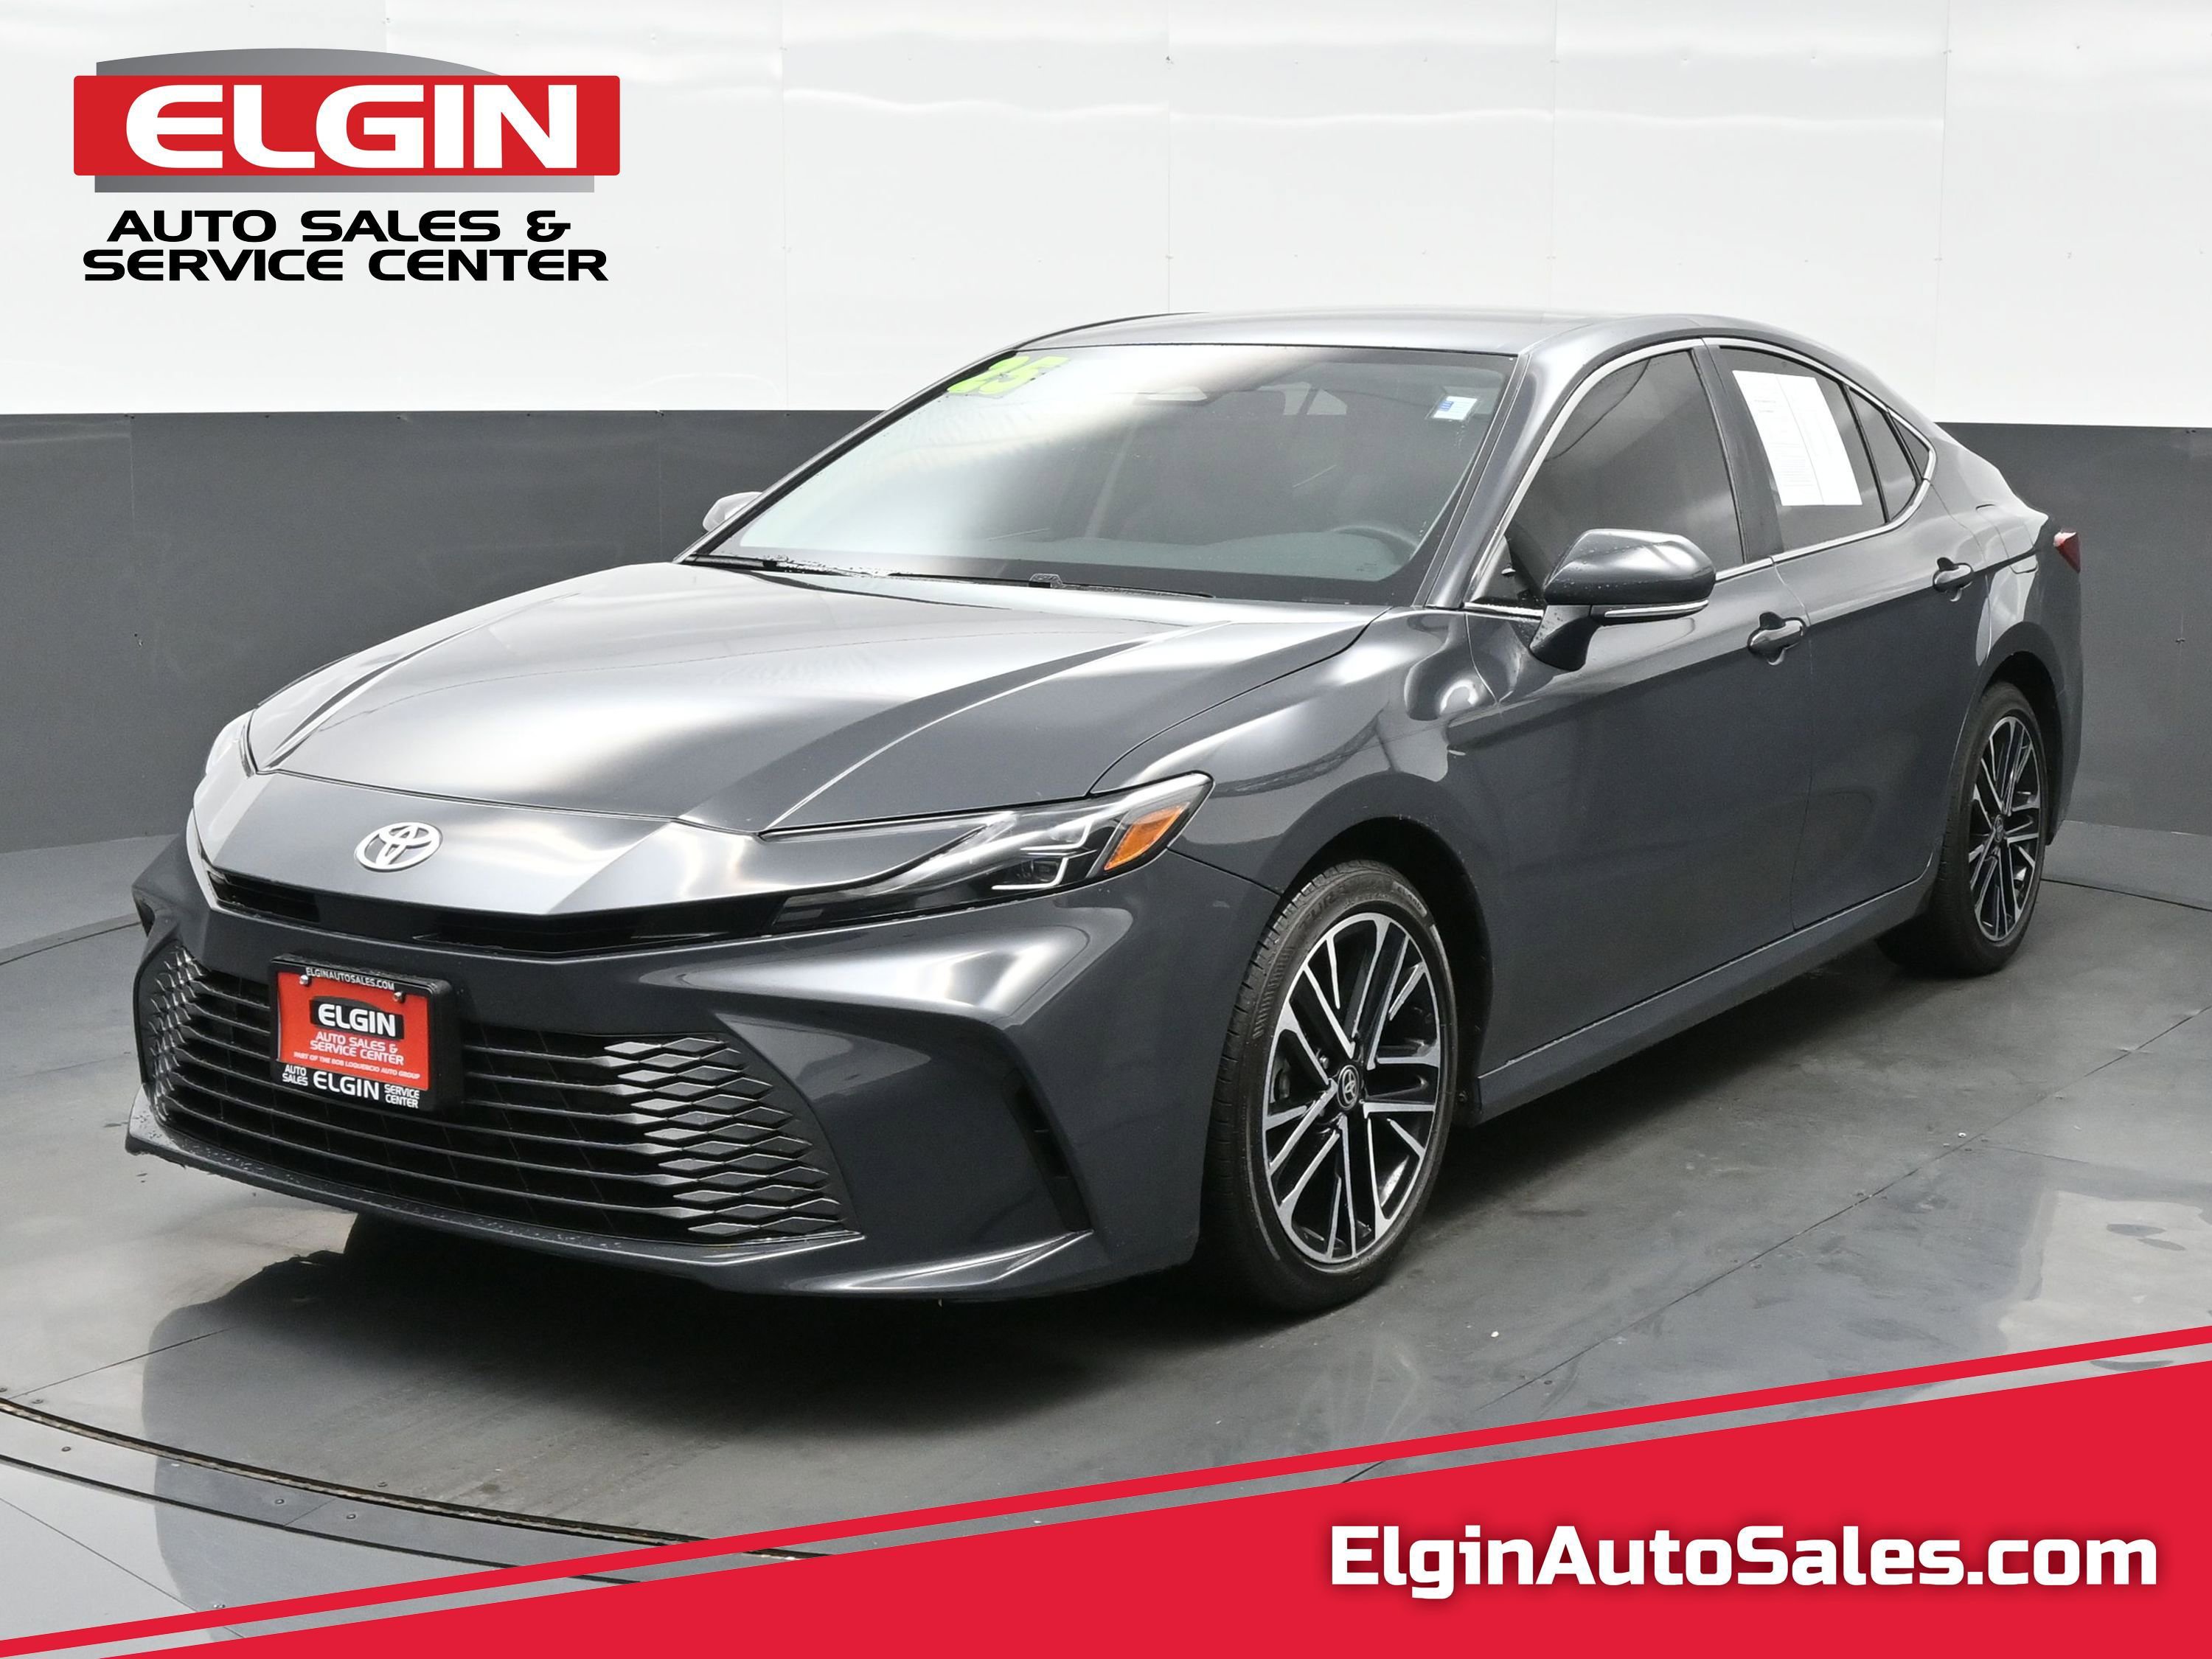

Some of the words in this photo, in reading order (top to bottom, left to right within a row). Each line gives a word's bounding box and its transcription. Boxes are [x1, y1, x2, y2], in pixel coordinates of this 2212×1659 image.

[305, 967, 395, 991] ELGINAUTOSALES.COM
[318, 1004, 396, 1037] ELGIN
[310, 1040, 357, 1057] SERVICE
[360, 1048, 404, 1066] CENTER
[316, 1032, 346, 1045] AUTO
[349, 1037, 386, 1052] SALES
[389, 1043, 398, 1054] &
[285, 1064, 307, 1077] AUTO
[293, 1051, 309, 1060] PART
[381, 1066, 397, 1076] AUTO
[398, 1071, 421, 1080] GROUP
[282, 1073, 308, 1086] SALES
[313, 1071, 380, 1101] ELGIN
[384, 1084, 420, 1099] SERVICE
[385, 1094, 419, 1109] CENTER
